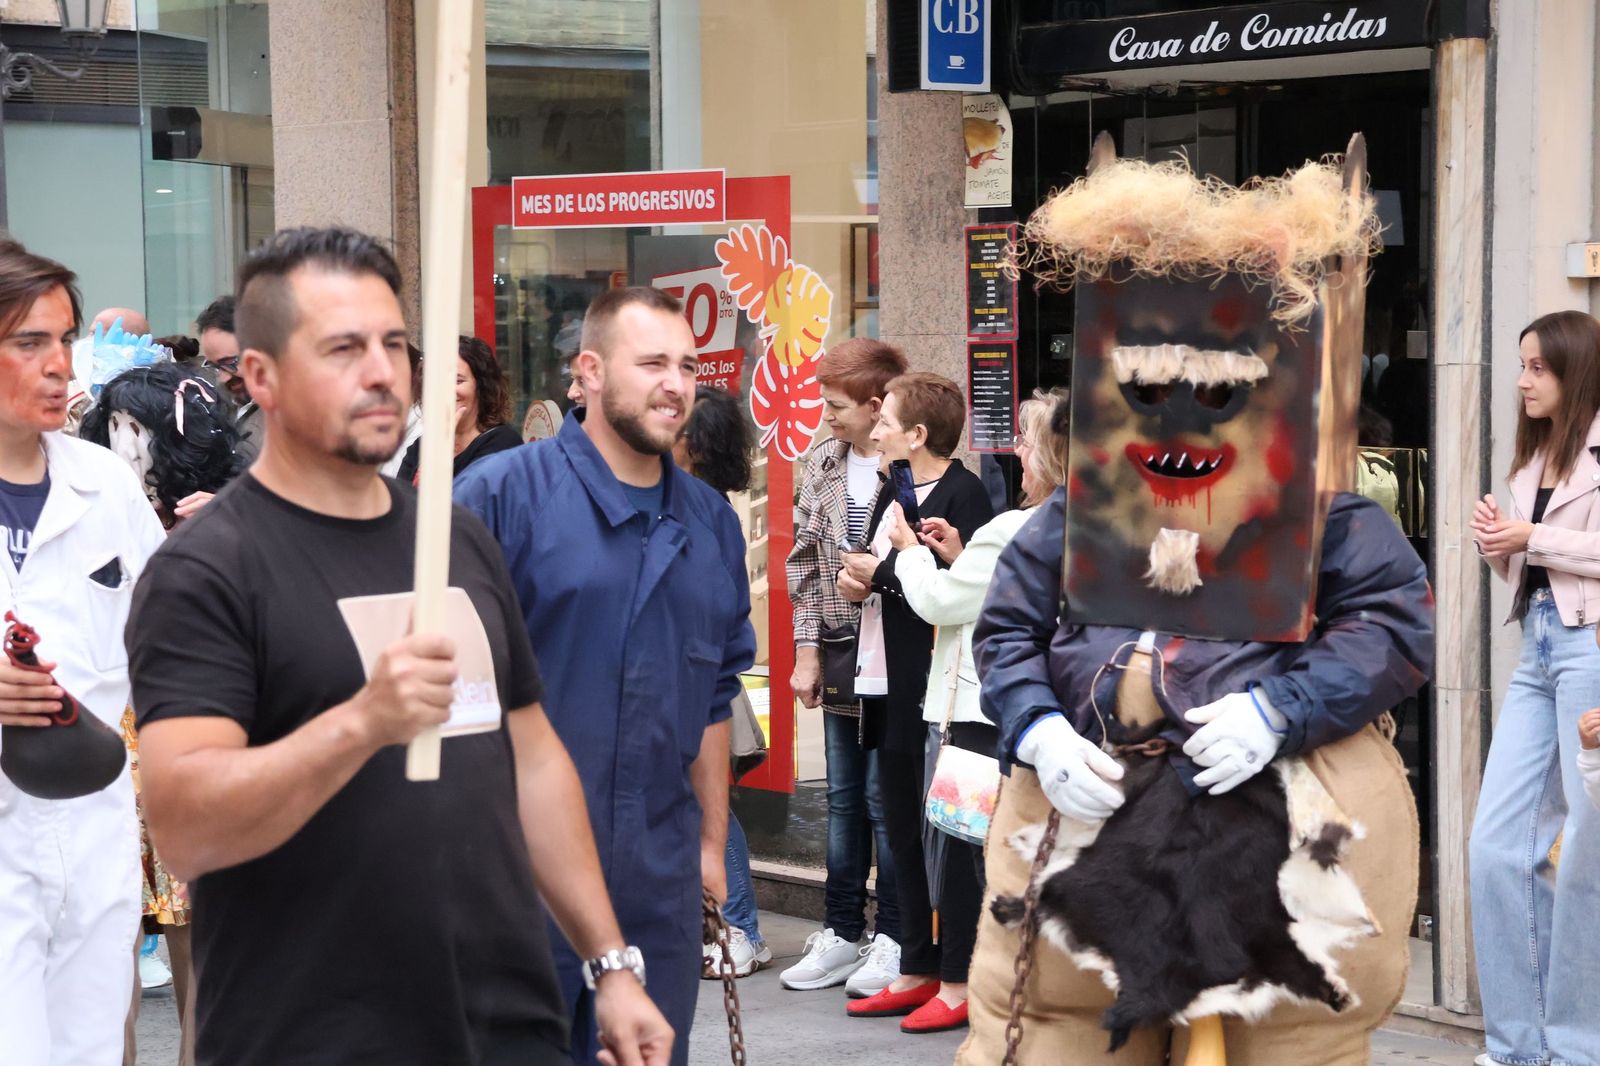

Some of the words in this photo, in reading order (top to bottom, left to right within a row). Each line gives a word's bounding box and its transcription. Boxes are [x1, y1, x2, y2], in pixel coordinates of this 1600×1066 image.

[932, 0, 980, 35] CB
[1109, 26, 1184, 63] Casa
[1190, 21, 1231, 54] de
[1240, 7, 1387, 51] Comidas
[968, 178, 1000, 190] TOMATE
[521, 194, 552, 215] MES
[555, 193, 575, 214] DE
[578, 192, 606, 213] LOS
[609, 188, 716, 212] PROGRESIVOS
[987, 190, 1011, 201] ACEITE
[662, 283, 719, 349] 0
[719, 309, 735, 318] DTO.
[719, 360, 736, 374] los
